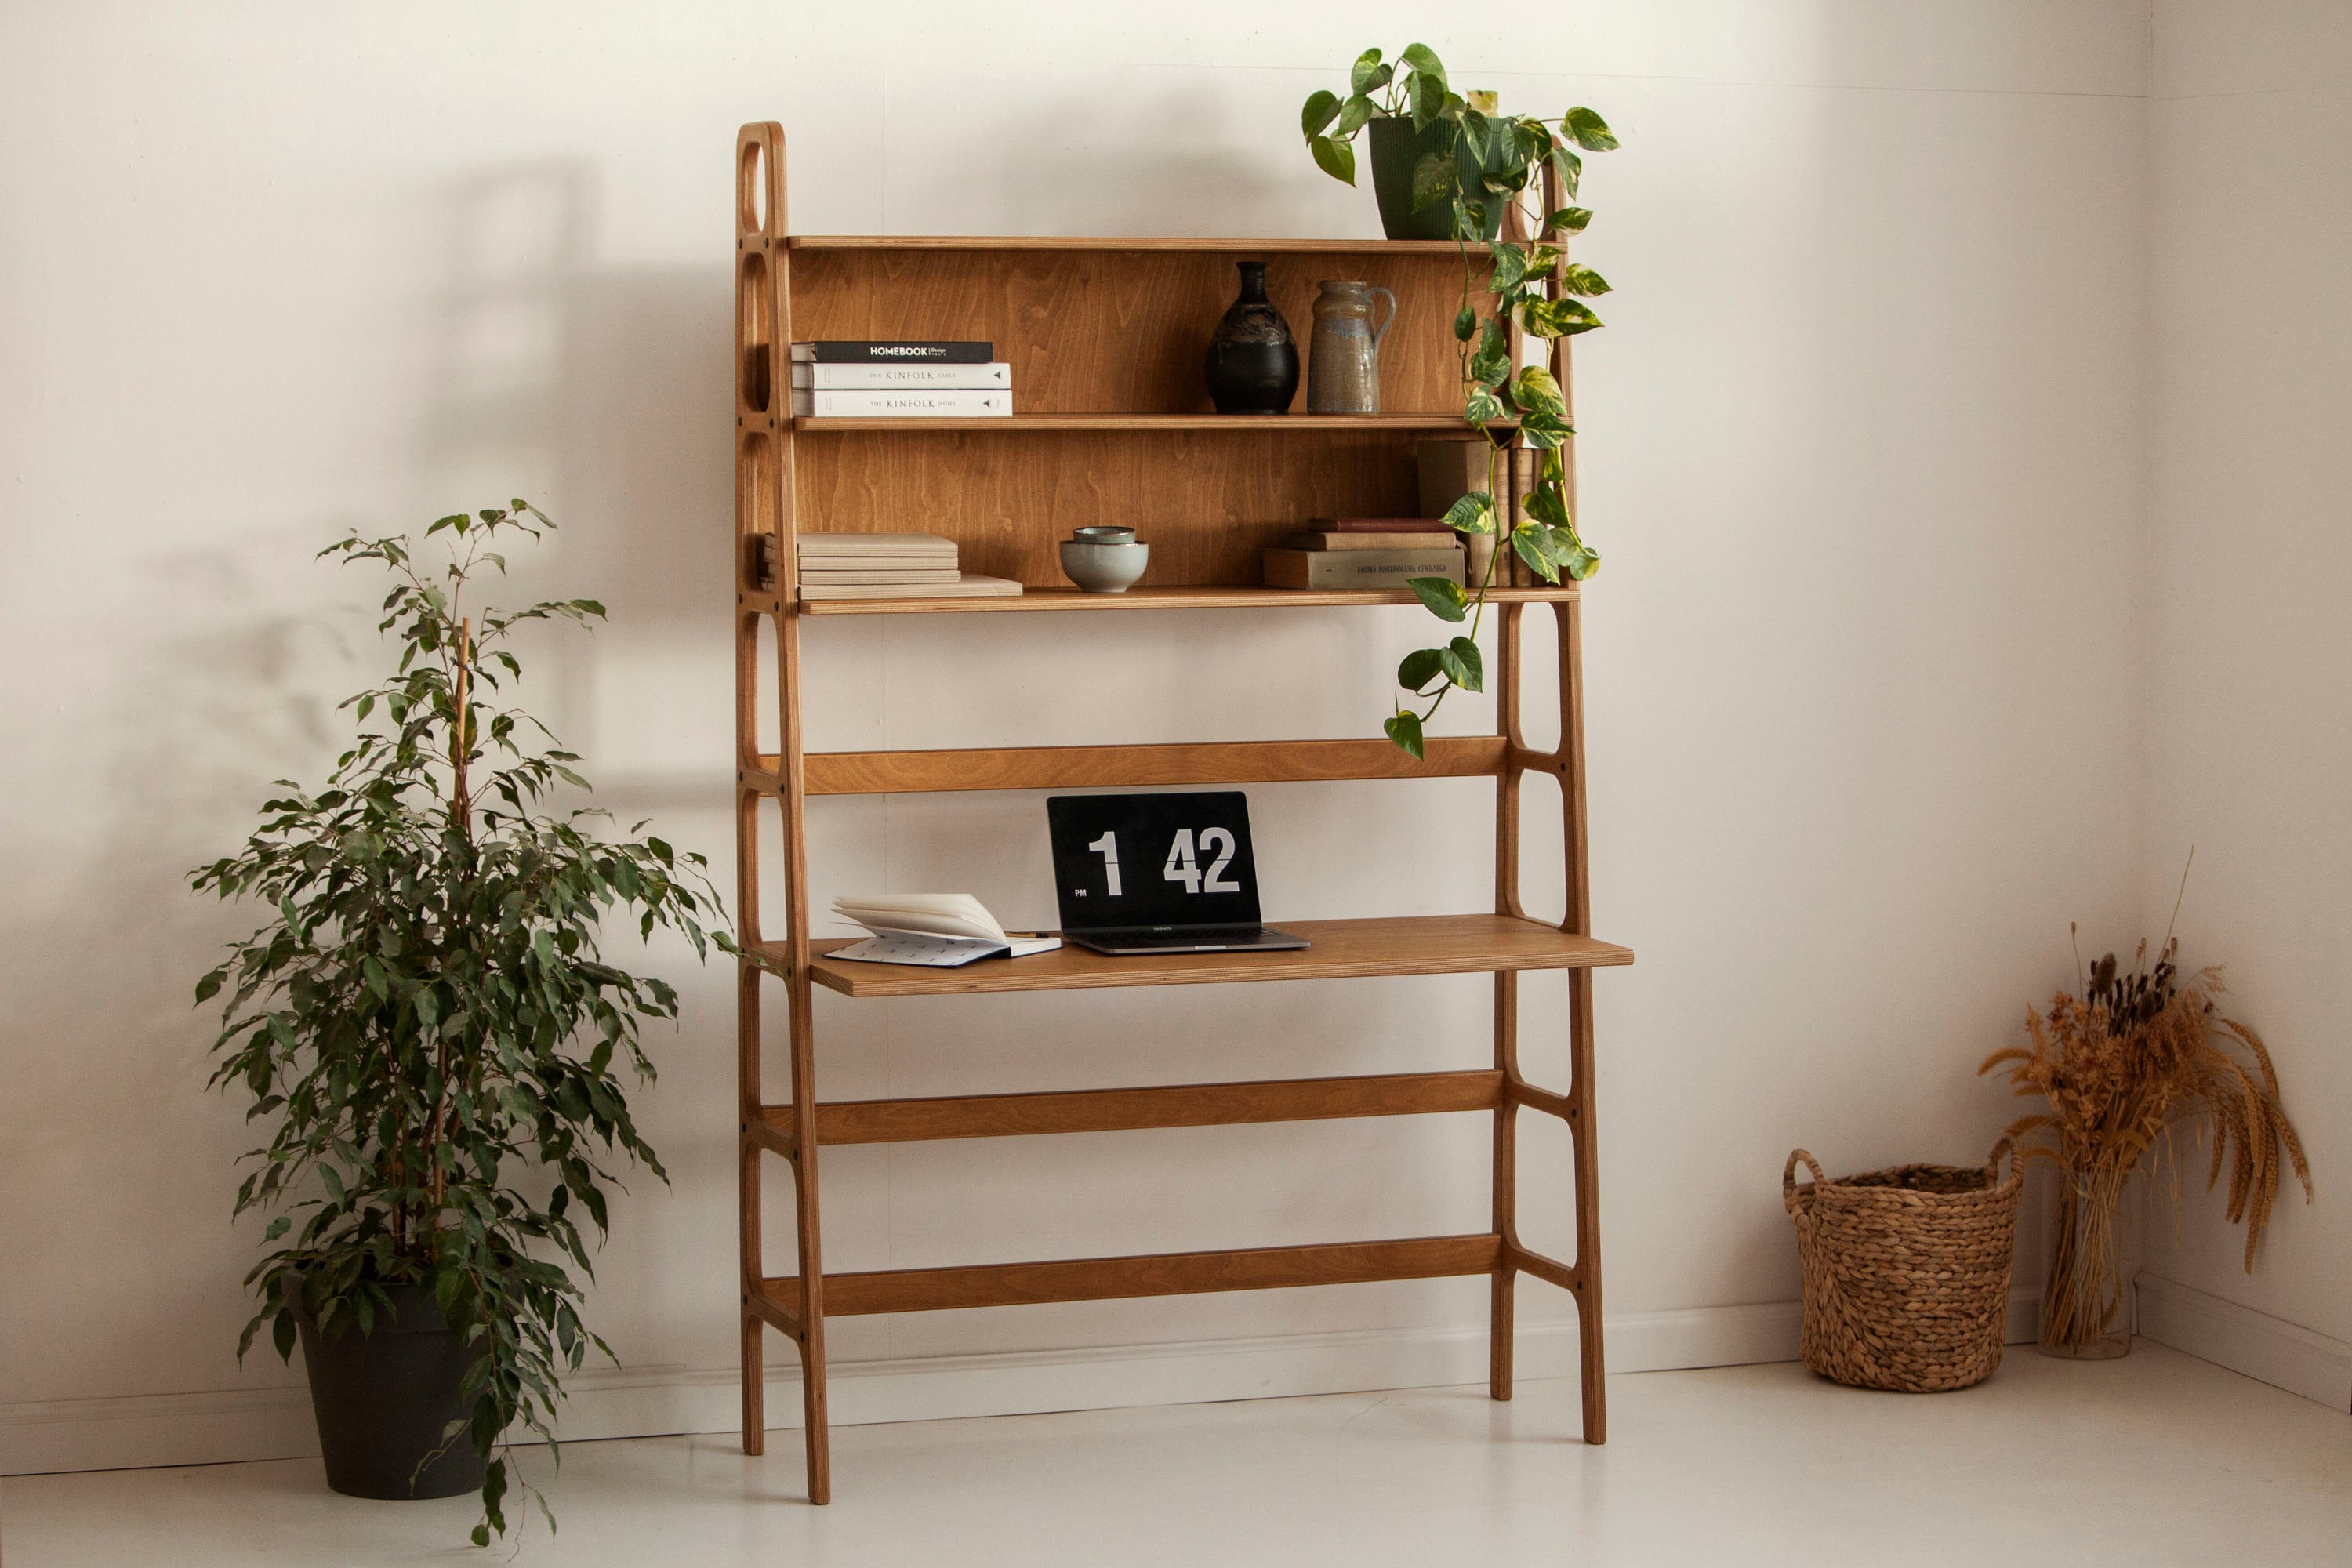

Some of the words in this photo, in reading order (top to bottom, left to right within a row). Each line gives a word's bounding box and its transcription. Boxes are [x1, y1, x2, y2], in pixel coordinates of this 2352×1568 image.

[870, 347, 927, 356] HOMEBOOK
[886, 371, 934, 379] KINFOLK
[887, 399, 935, 408] KINFOLK
[1088, 831, 1122, 896] 1
[1163, 826, 1240, 894] 42
[1075, 889, 1087, 898] PM
